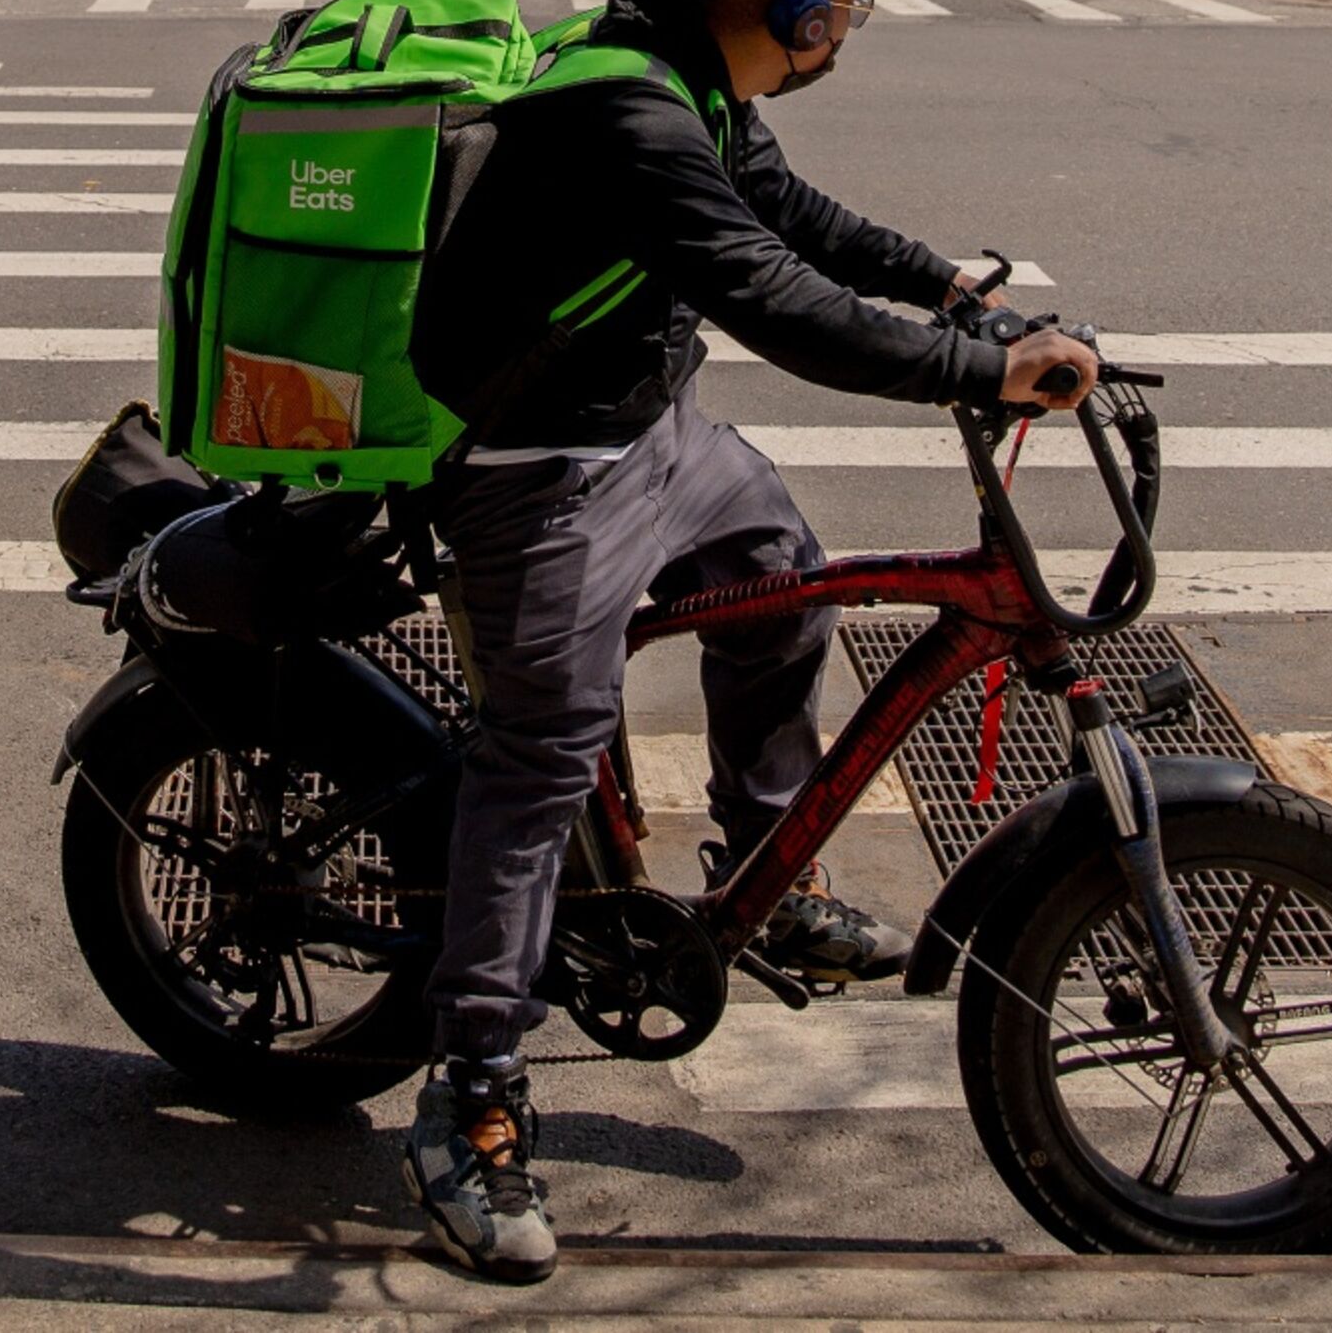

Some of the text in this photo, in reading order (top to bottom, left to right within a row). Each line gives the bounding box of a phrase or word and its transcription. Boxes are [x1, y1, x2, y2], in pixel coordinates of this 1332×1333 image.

[291, 159, 356, 186] Uber
[290, 186, 355, 212] Eats
[224, 370, 247, 445] peeled
